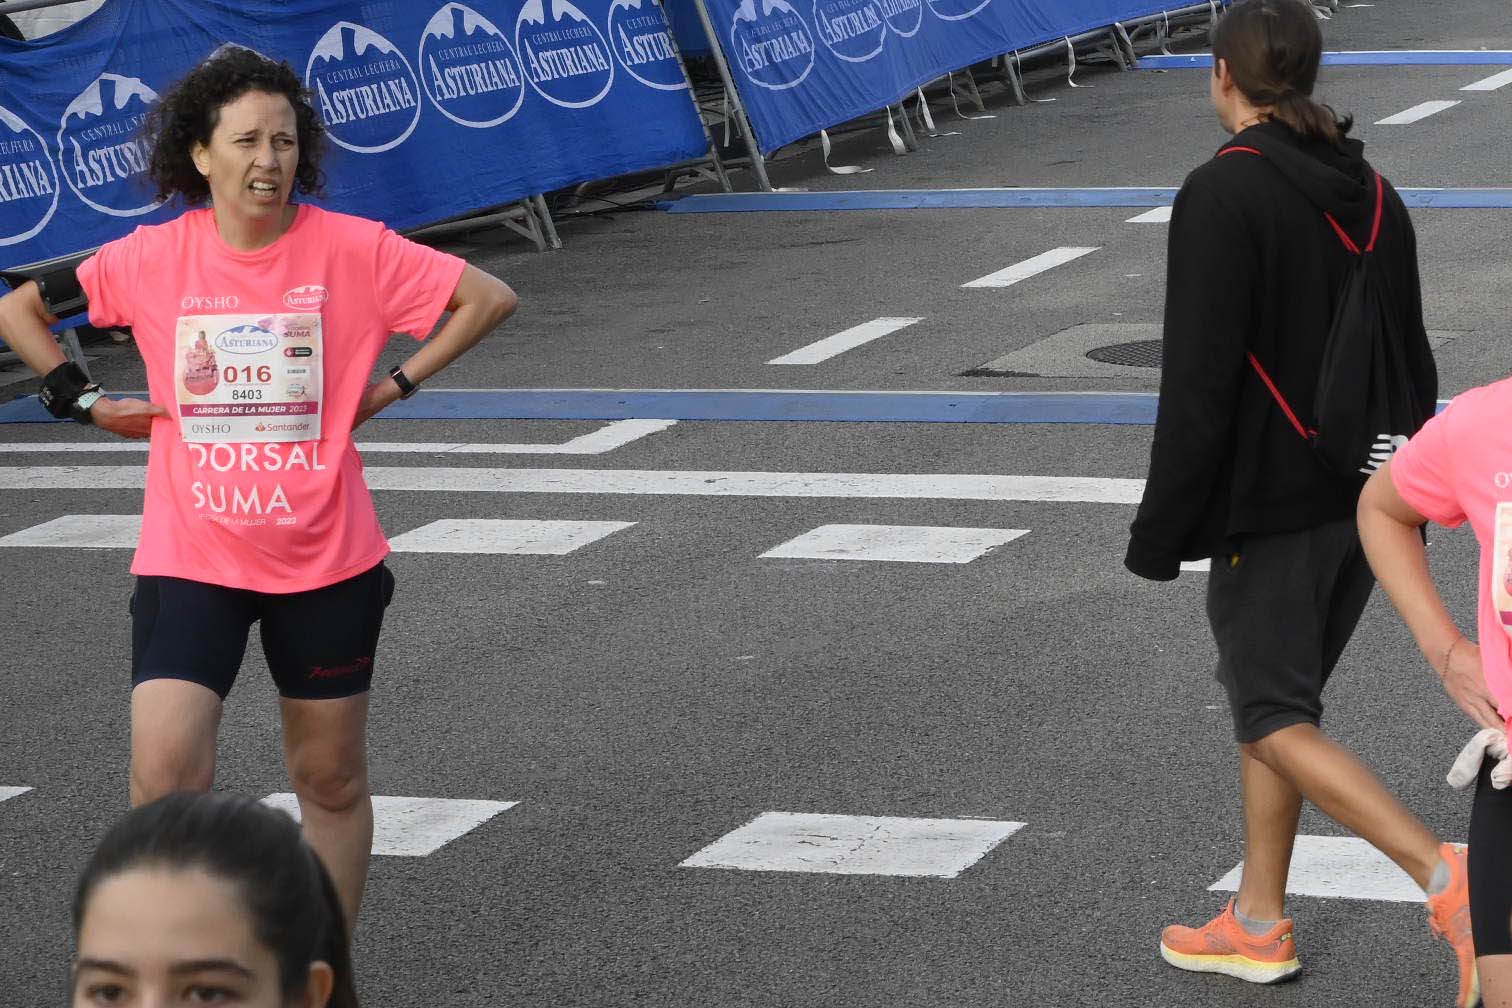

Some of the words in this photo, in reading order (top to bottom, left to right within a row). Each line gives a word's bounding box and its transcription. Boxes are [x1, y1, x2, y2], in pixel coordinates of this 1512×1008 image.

[524, 36, 610, 83] ASTURIANA
[428, 52, 521, 102] ASTURIANA
[315, 76, 417, 126] ASTURIANA
[0, 139, 34, 156] ECHERA
[180, 295, 240, 310] OYSHO
[219, 336, 275, 349] ASTURIANA
[223, 365, 272, 384] 016
[231, 389, 263, 401] 8403
[192, 406, 230, 414] CARRERA
[231, 406, 247, 414] DE
[258, 405, 287, 413] MUJER
[191, 423, 232, 434] OYSHO
[266, 422, 310, 432] Santander
[191, 481, 293, 515] SUMA
